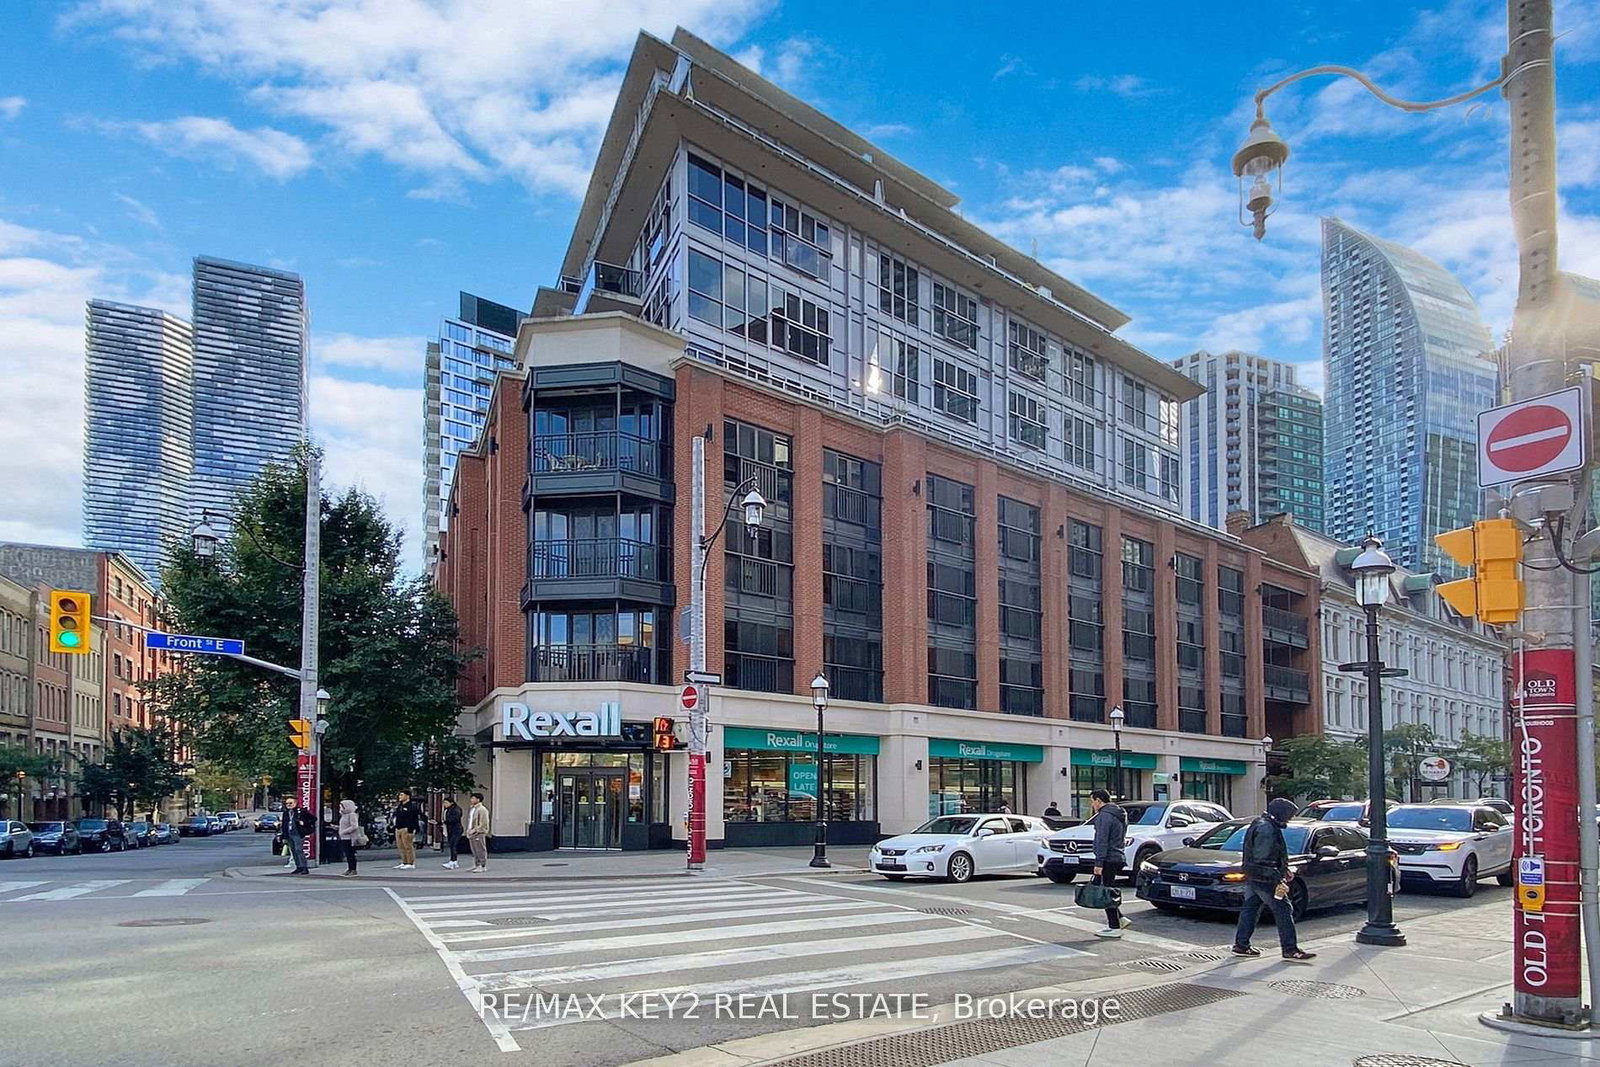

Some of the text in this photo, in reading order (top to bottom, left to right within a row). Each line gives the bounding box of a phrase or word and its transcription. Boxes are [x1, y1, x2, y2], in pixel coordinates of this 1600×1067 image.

[166, 636, 203, 651] Front
[216, 640, 224, 650] E
[1528, 680, 1556, 688] OLD
[502, 702, 622, 741] Rexall
[767, 733, 838, 752] Rexall Drutore
[959, 743, 986, 756] Rexall
[793, 771, 818, 780] OPEN
[794, 783, 816, 791] LATE
[1521, 737, 1544, 847] TORONTO
[1523, 931, 1548, 987] OLD
